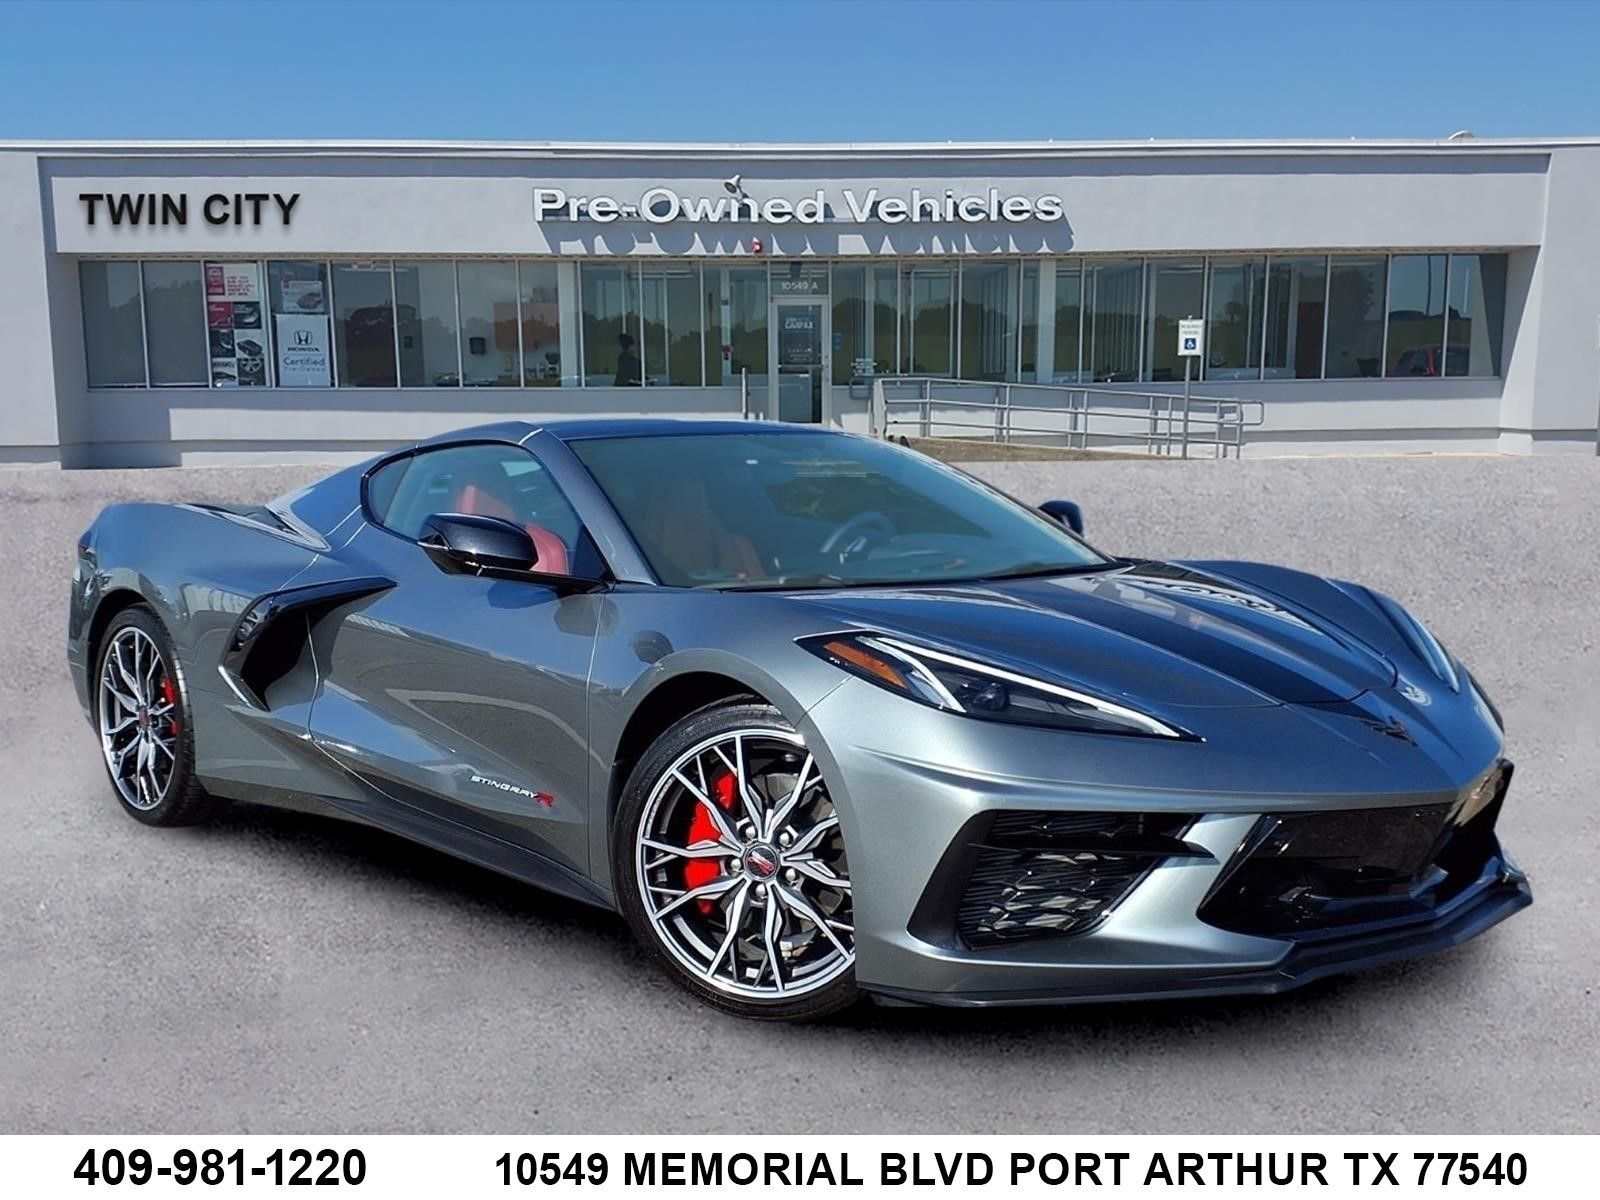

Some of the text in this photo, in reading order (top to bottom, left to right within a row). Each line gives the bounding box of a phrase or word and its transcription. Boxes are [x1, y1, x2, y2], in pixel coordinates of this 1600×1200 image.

[79, 193, 300, 226] TWIN CITY
[533, 187, 1064, 223] Pre-Owned Vehicles
[781, 281, 819, 290] 10549 A
[283, 356, 326, 366] Certified
[470, 775, 538, 798] STINGRAY
